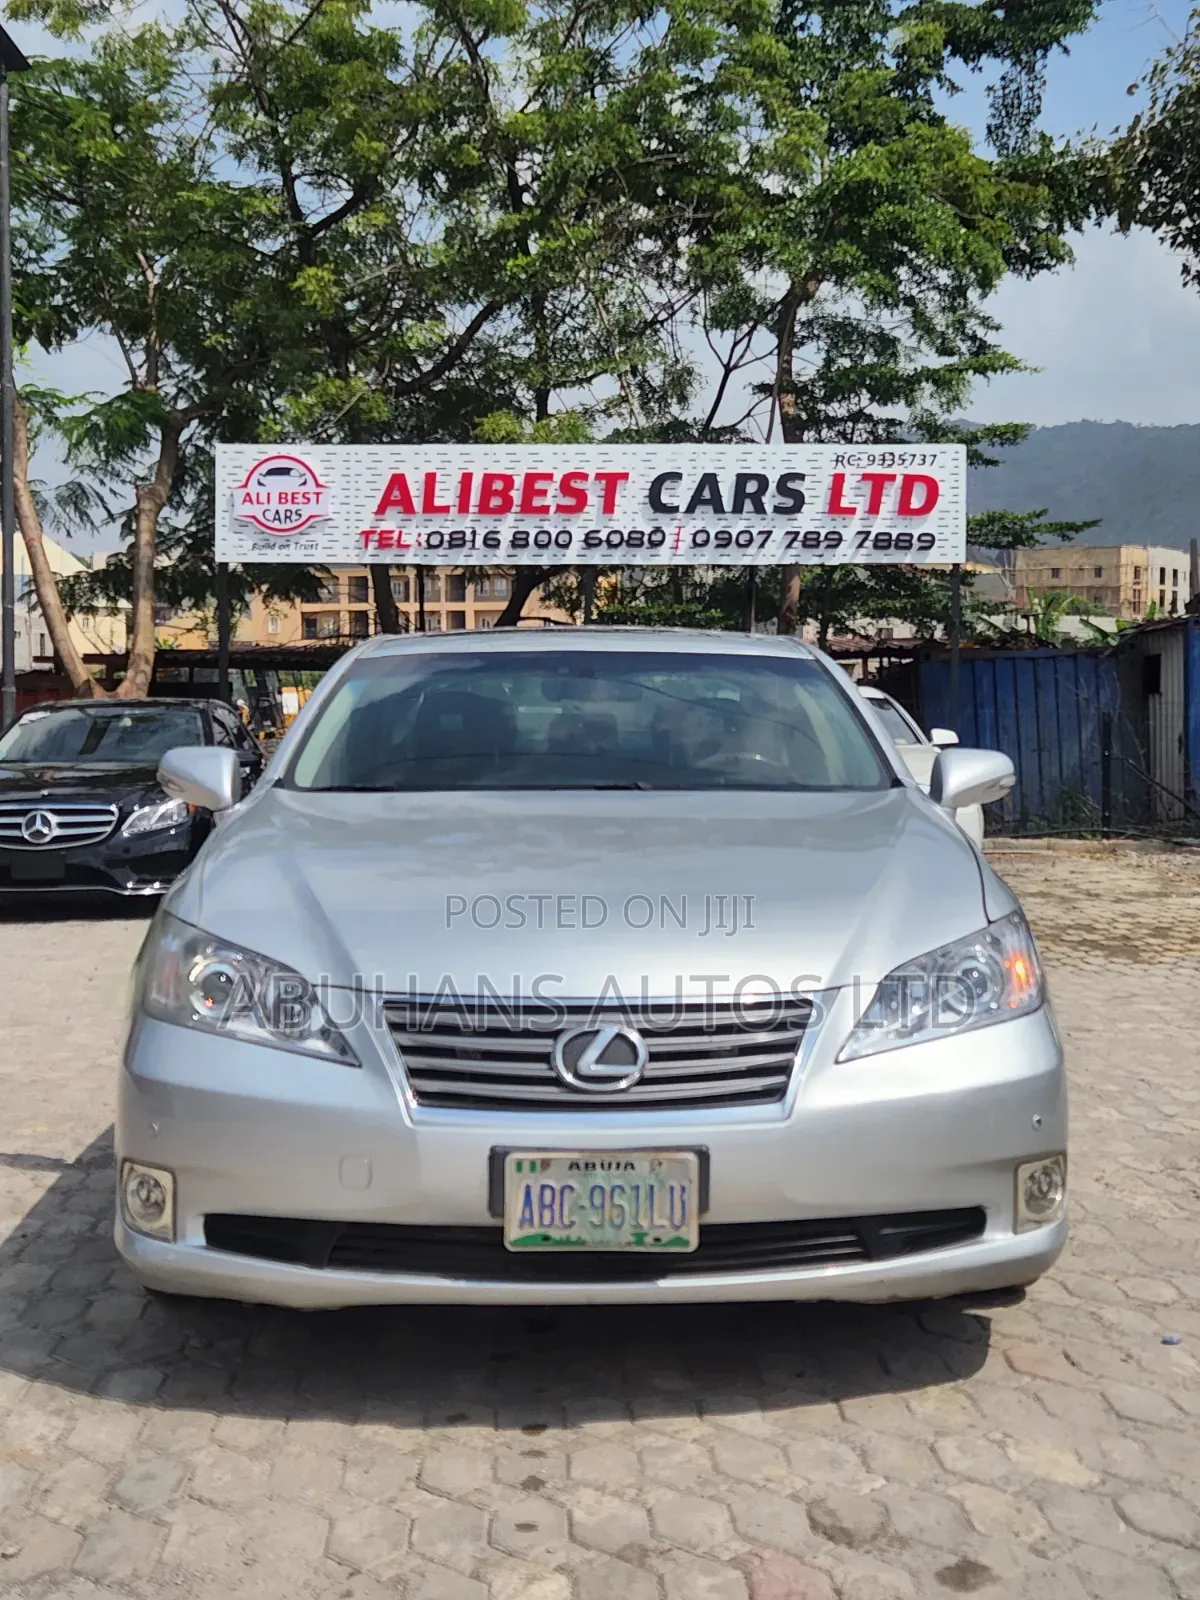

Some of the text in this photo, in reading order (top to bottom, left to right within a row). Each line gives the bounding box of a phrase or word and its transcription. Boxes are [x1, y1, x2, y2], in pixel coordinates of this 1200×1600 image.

[241, 491, 323, 505] ALI BEST
[374, 471, 940, 517] ALIBEST CARS LTD
[262, 508, 303, 525] CARS
[294, 542, 319, 551] Trust
[510, 529, 573, 550] 800
[583, 529, 666, 550] 6080
[691, 529, 773, 550] 0907
[784, 530, 844, 550] 789
[854, 530, 937, 551] 7889
[567, 1160, 636, 1172] ABUJA
